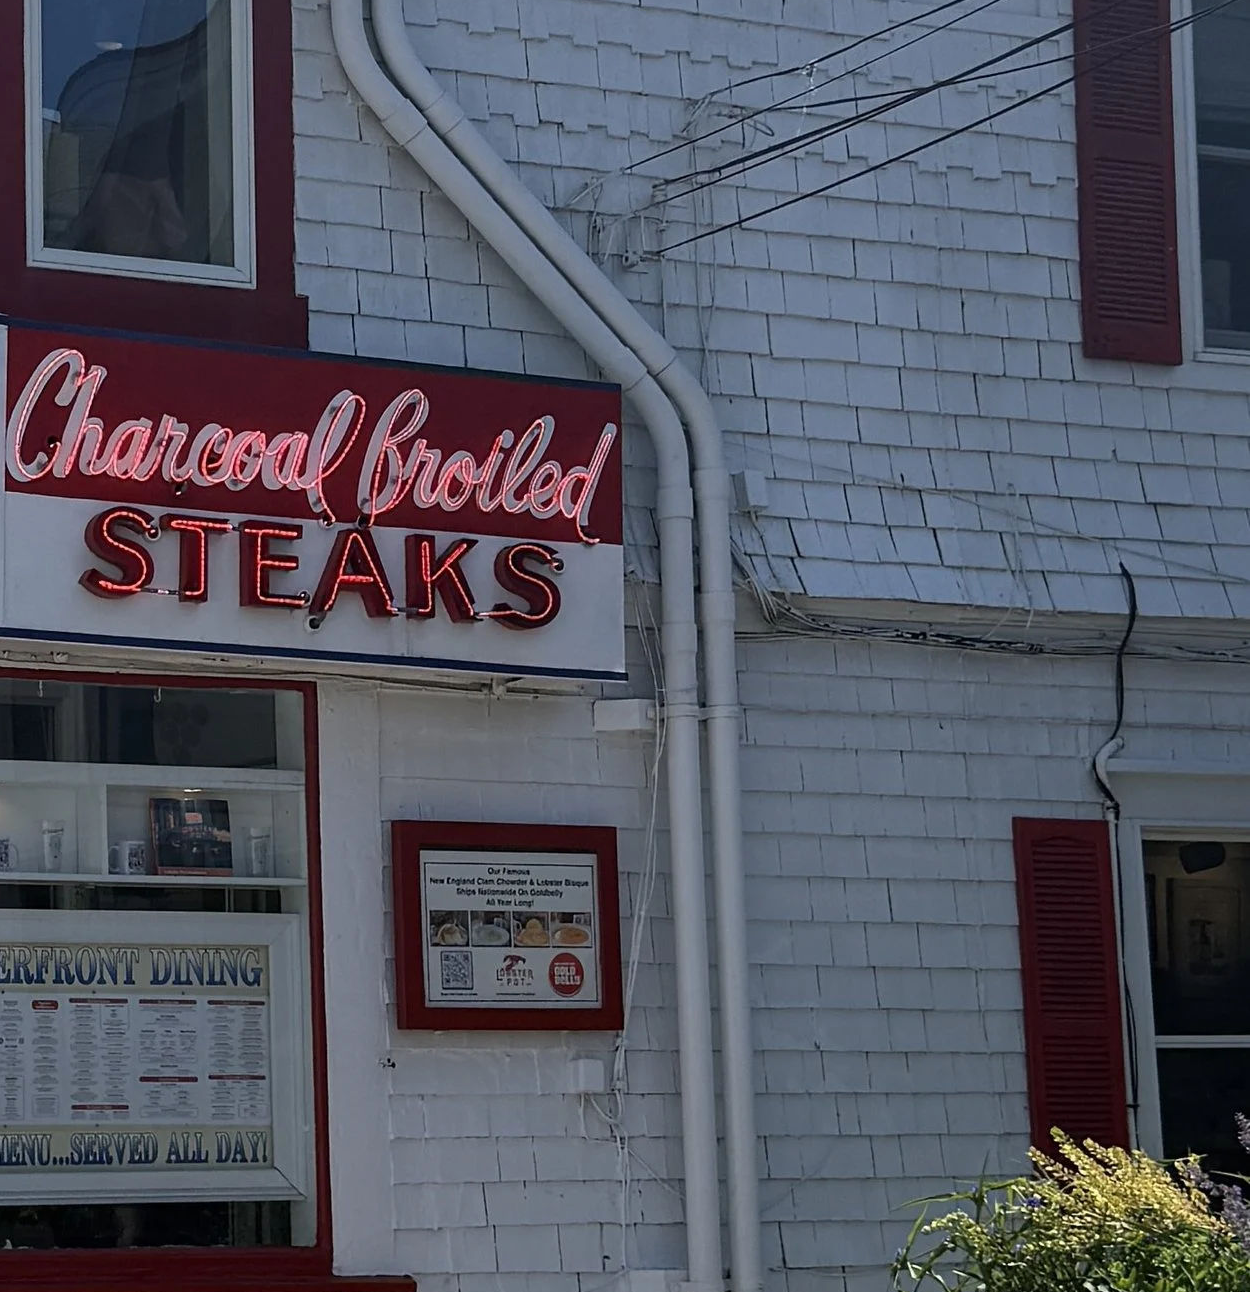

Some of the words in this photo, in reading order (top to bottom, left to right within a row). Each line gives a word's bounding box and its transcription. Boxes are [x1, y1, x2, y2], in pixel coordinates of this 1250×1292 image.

[6, 348, 366, 526] Charcoal
[78, 506, 565, 631] STEAKS
[429, 877, 445, 885] New
[446, 877, 475, 887] England
[477, 877, 495, 886] Clam
[496, 878, 527, 886] Chowder
[487, 867, 501, 876] Our
[502, 867, 531, 876] Famous
[149, 946, 264, 987] DINING
[165, 1132, 210, 1165] ALL
[215, 1131, 269, 1165] DAY!
